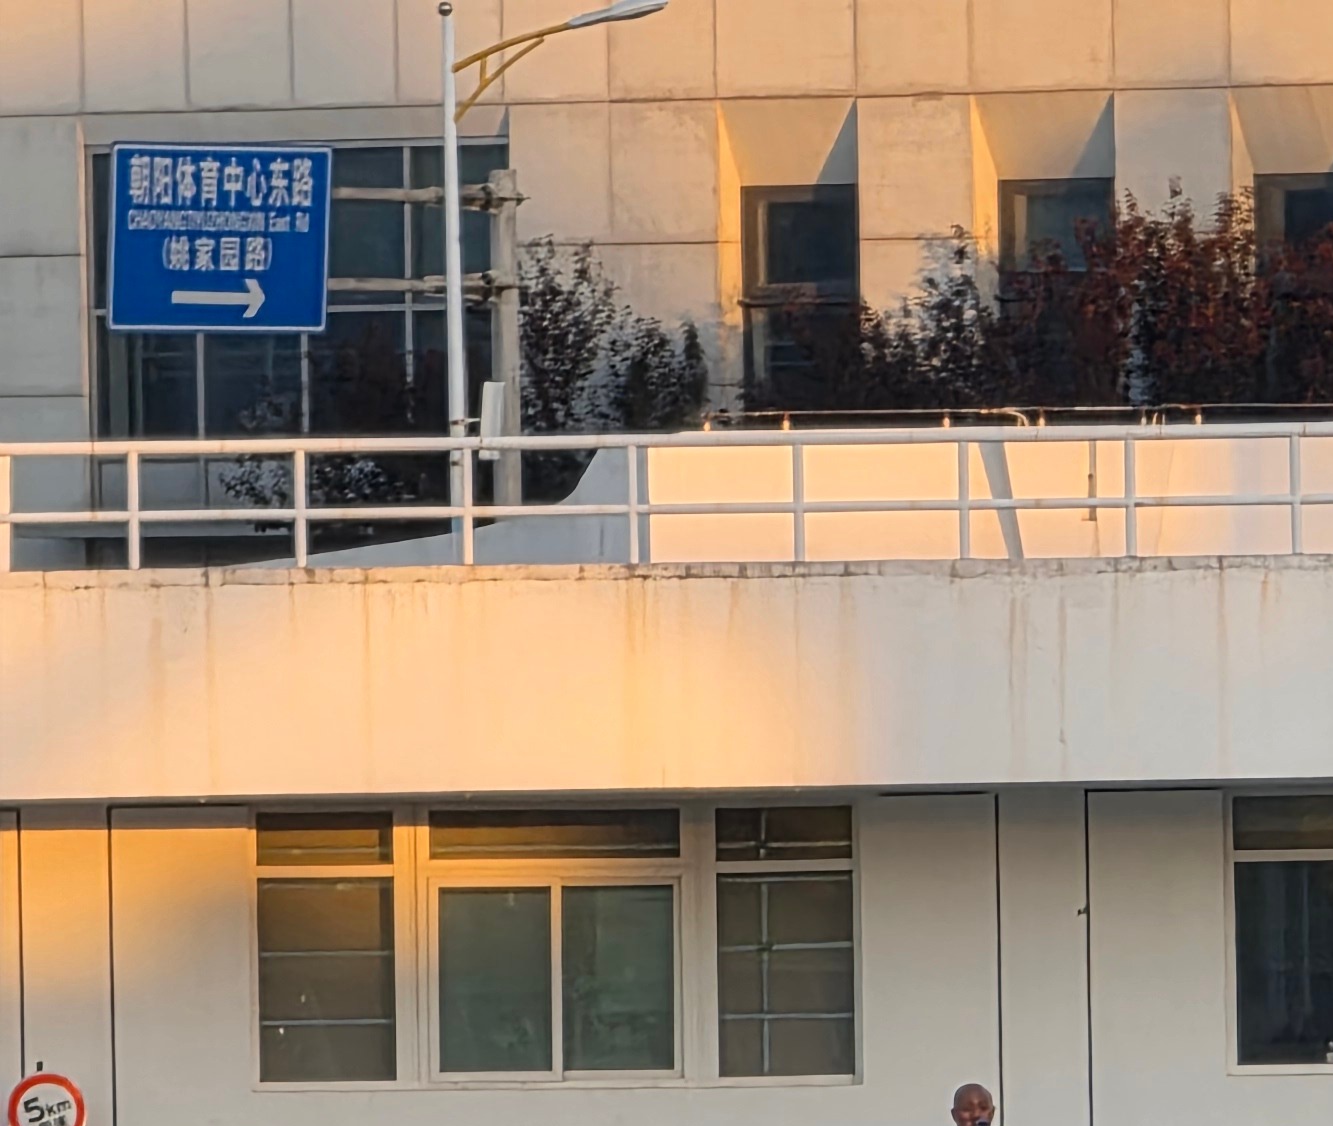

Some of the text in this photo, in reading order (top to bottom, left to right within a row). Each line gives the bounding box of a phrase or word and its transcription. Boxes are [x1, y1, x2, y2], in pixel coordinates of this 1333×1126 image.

[129, 154, 313, 206] 朝阳体育中心东路
